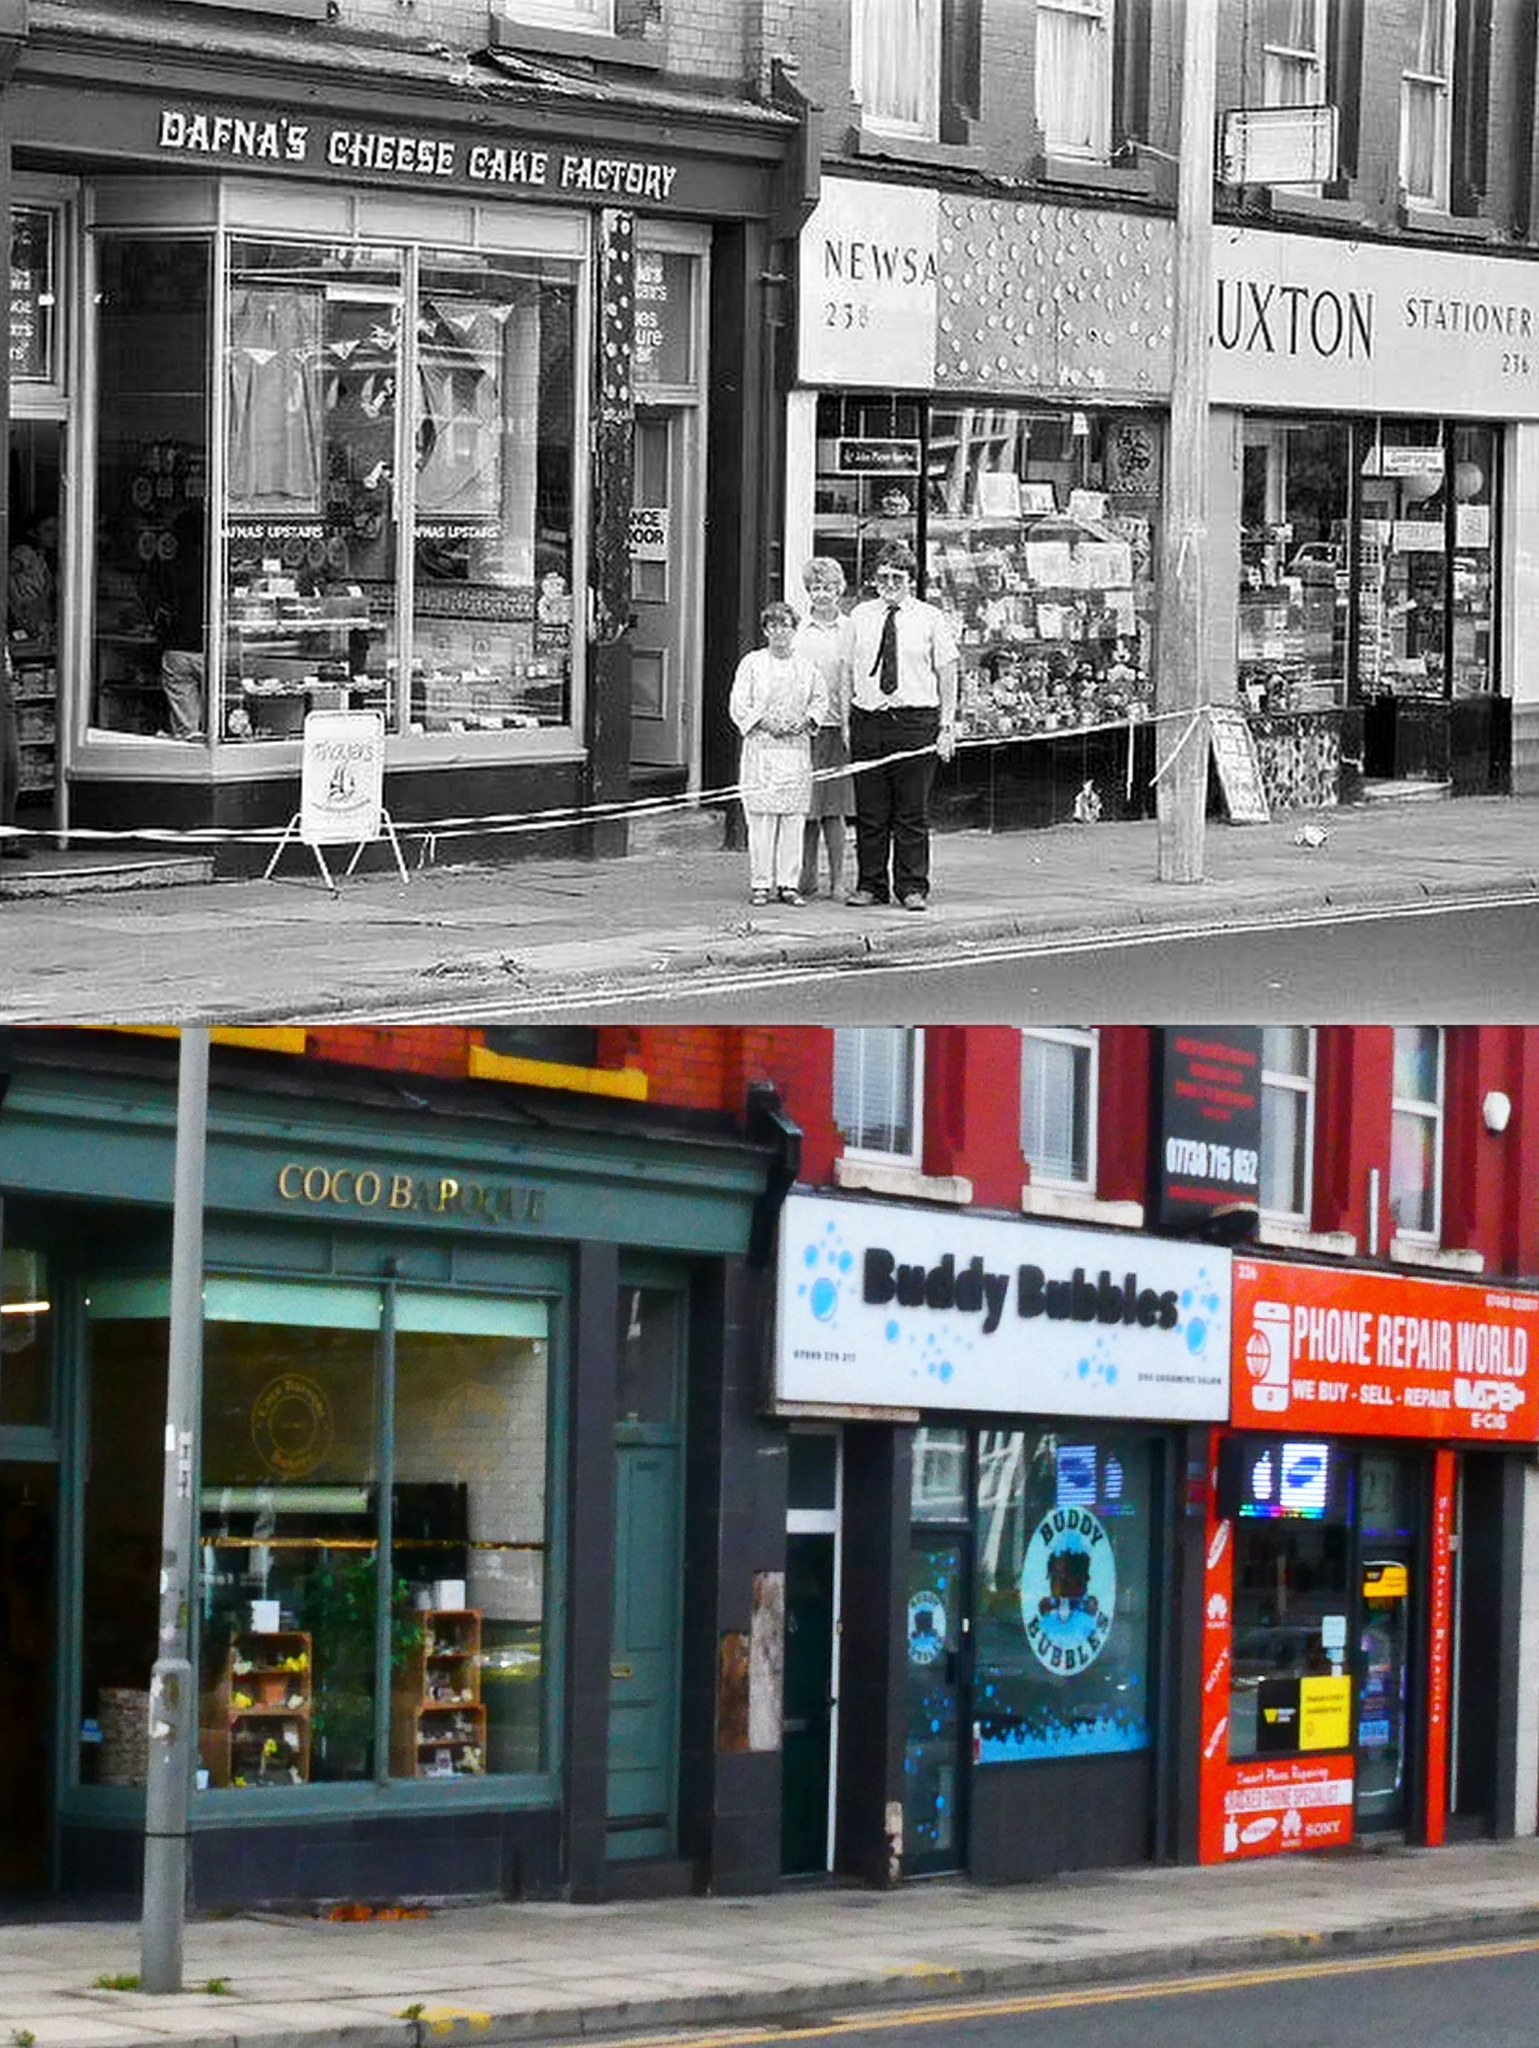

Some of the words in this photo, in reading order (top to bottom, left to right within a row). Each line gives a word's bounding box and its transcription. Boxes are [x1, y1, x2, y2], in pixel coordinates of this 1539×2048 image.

[159, 111, 309, 161] DAFNA'S
[327, 131, 455, 176] CHEESE
[469, 147, 549, 186] CAKE
[561, 156, 678, 200] FACTORY
[279, 1162, 381, 1207] COCO
[864, 1247, 1010, 1334] Buddy
[1017, 1263, 1179, 1330] Bubbles
[1293, 1305, 1373, 1367] PHONE
[1377, 1314, 1452, 1373] REPAIR
[1457, 1320, 1528, 1378] WORLD
[1292, 1379, 1316, 1401] WE
[1319, 1380, 1349, 1404] BUY
[1360, 1384, 1394, 1407] SELL
[1404, 1386, 1451, 1410] REPAIR
[1040, 1508, 1104, 1547] BUDDY
[1027, 1610, 1110, 1671] BUBBLES
